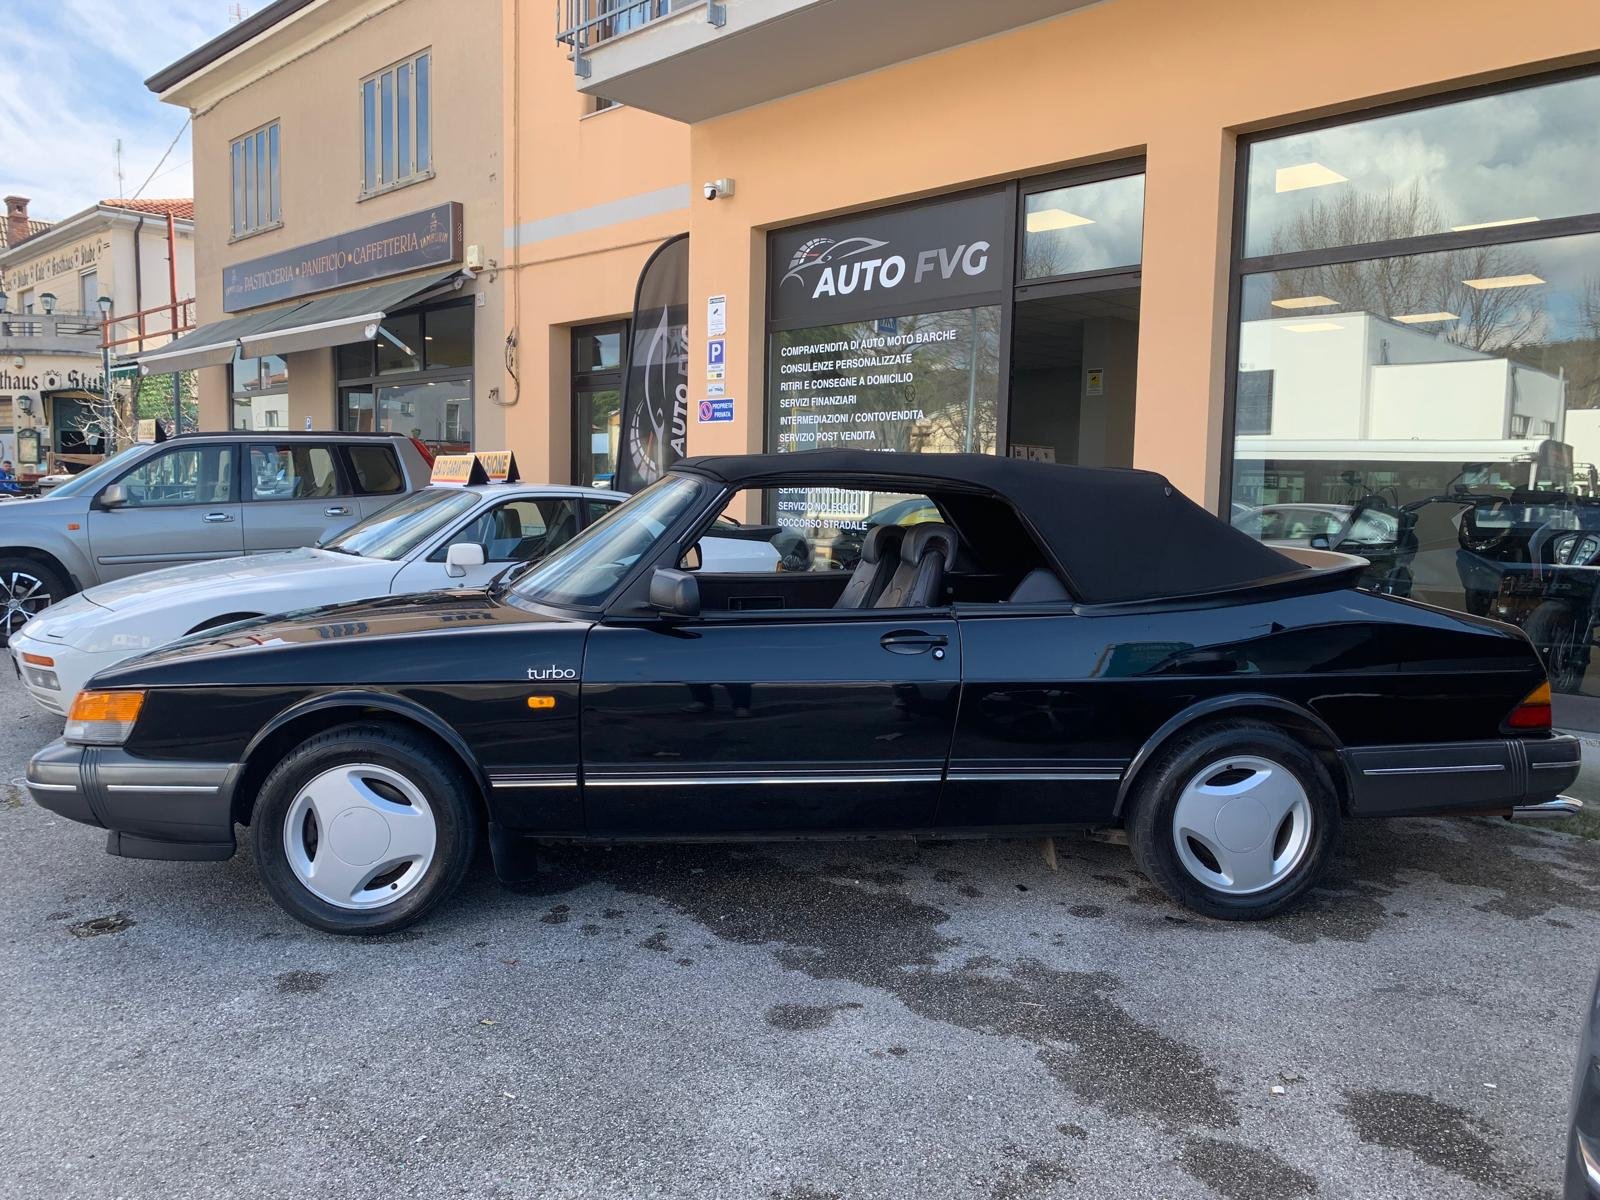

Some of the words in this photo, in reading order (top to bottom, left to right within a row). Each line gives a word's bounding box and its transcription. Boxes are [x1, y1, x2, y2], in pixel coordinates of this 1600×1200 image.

[243, 265, 294, 290] PASTICCERIA
[301, 251, 346, 278] PANIFICIO
[353, 232, 419, 265] CAFFETTERIA
[812, 255, 906, 299] AUTO
[914, 241, 991, 284] FVG
[711, 343, 722, 362] P
[781, 341, 849, 357] COMPRAVENDITA
[850, 340, 859, 350] DI
[860, 338, 885, 349] AUTO
[886, 335, 914, 346] MOTO
[915, 329, 957, 344] BARCHE
[780, 361, 834, 374] CONSULENZE
[836, 353, 913, 370] PERSONALIZZATE
[780, 381, 803, 392] RITIRI
[804, 380, 810, 390] E
[811, 377, 857, 389] CONSEGNE
[858, 376, 865, 386] A
[867, 372, 914, 385] DOMICILIO
[780, 397, 810, 408] SERVIZI
[811, 395, 857, 407] FINANZIARI
[670, 383, 688, 458] AUTO
[780, 413, 849, 426] INTERMEDIAZIONI
[855, 409, 924, 423] CONTOVENDITA
[779, 432, 815, 443] SERVIZIO
[816, 431, 839, 441] POST
[840, 430, 876, 441] VENDITA
[778, 501, 813, 511] SERVIZIO
[815, 502, 859, 513] NOLEGGIO
[777, 517, 822, 529] SOCCORSO
[823, 519, 868, 531] STRADALE
[527, 664, 576, 679] turbo
